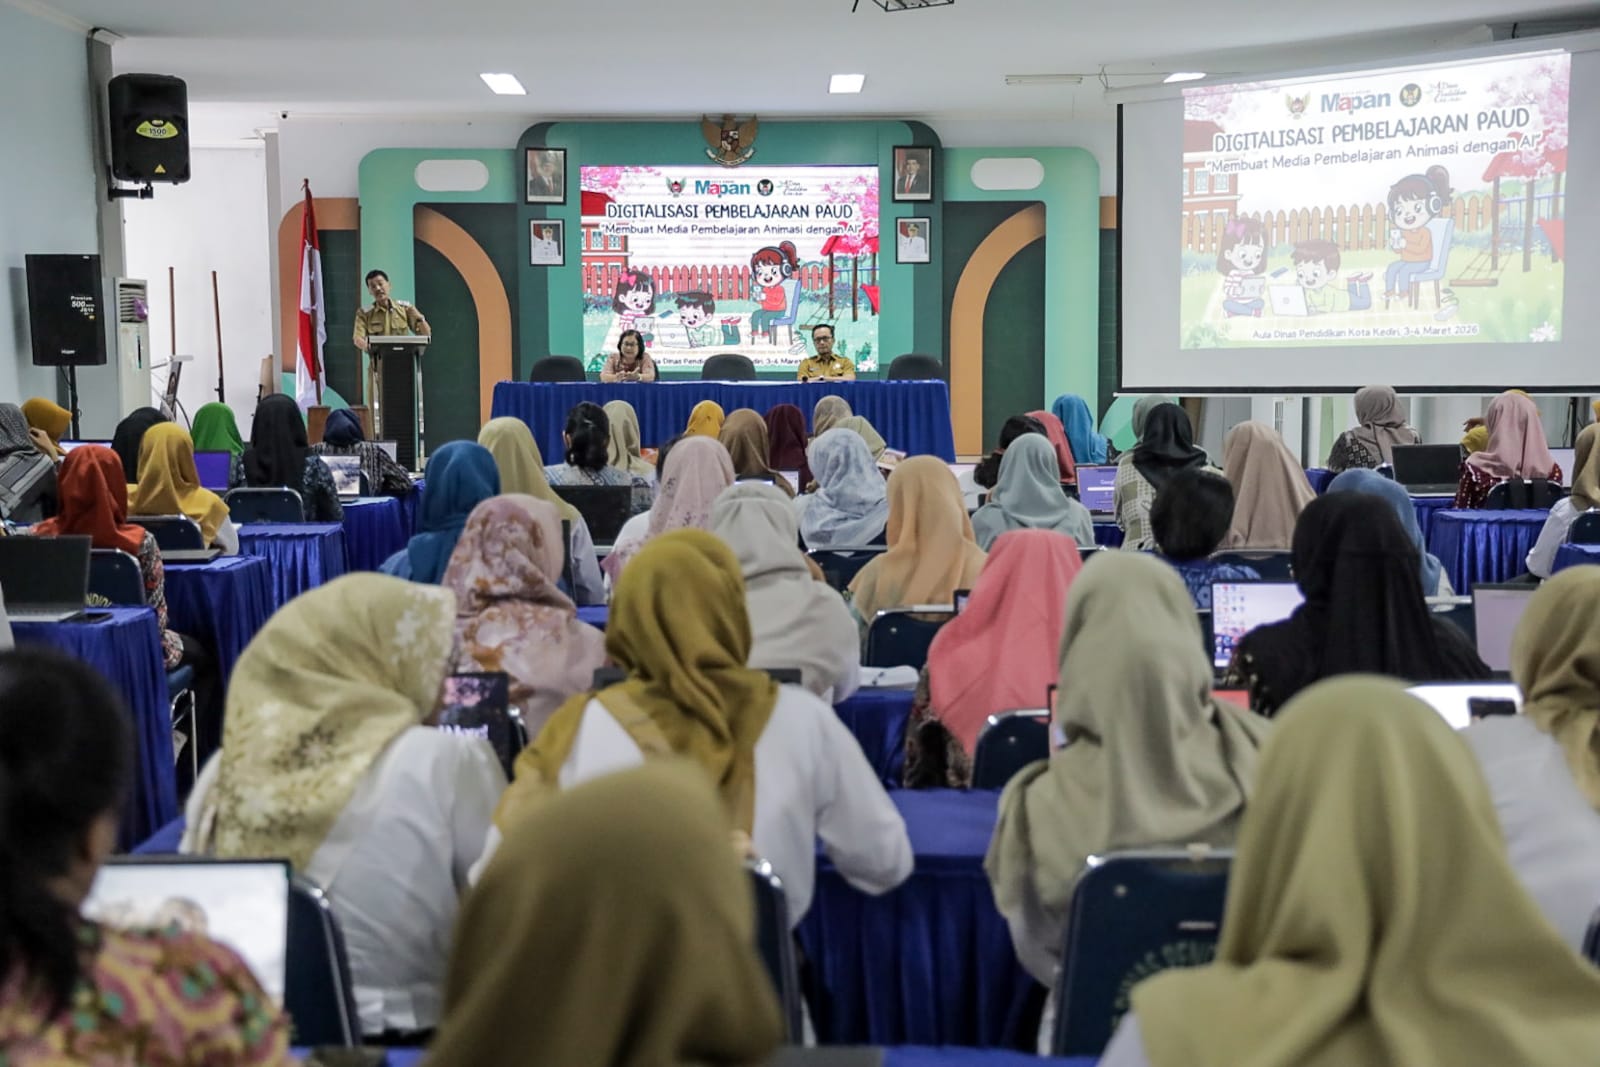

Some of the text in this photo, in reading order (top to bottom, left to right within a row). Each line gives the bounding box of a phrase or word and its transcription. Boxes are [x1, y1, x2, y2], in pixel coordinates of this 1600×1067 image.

[1321, 92, 1391, 116] Mapan
[1215, 107, 1530, 152] DIGITALISASI PEMBELAJARAN PAUD
[1272, 154, 1311, 168] Media
[1314, 148, 1402, 166] Pembelajaran
[1405, 143, 1459, 158] Animasi
[1463, 138, 1516, 154] dengan
[695, 180, 750, 199] Mapan
[608, 204, 853, 219] DIGITALISASI PEMBELAJARAN PAUD
[657, 224, 688, 234] Media
[691, 223, 760, 235] Pembelajaran
[764, 224, 803, 234] Animasi
[806, 223, 844, 236] dengan
[1252, 330, 1272, 339] Aula
[1274, 330, 1297, 338] Dinas
[1299, 329, 1346, 338] Pendidikan
[1348, 328, 1370, 337] Kota
[1403, 326, 1420, 336] 3-4
[1423, 325, 1451, 335] Maret
[1455, 324, 1478, 334] 2026
